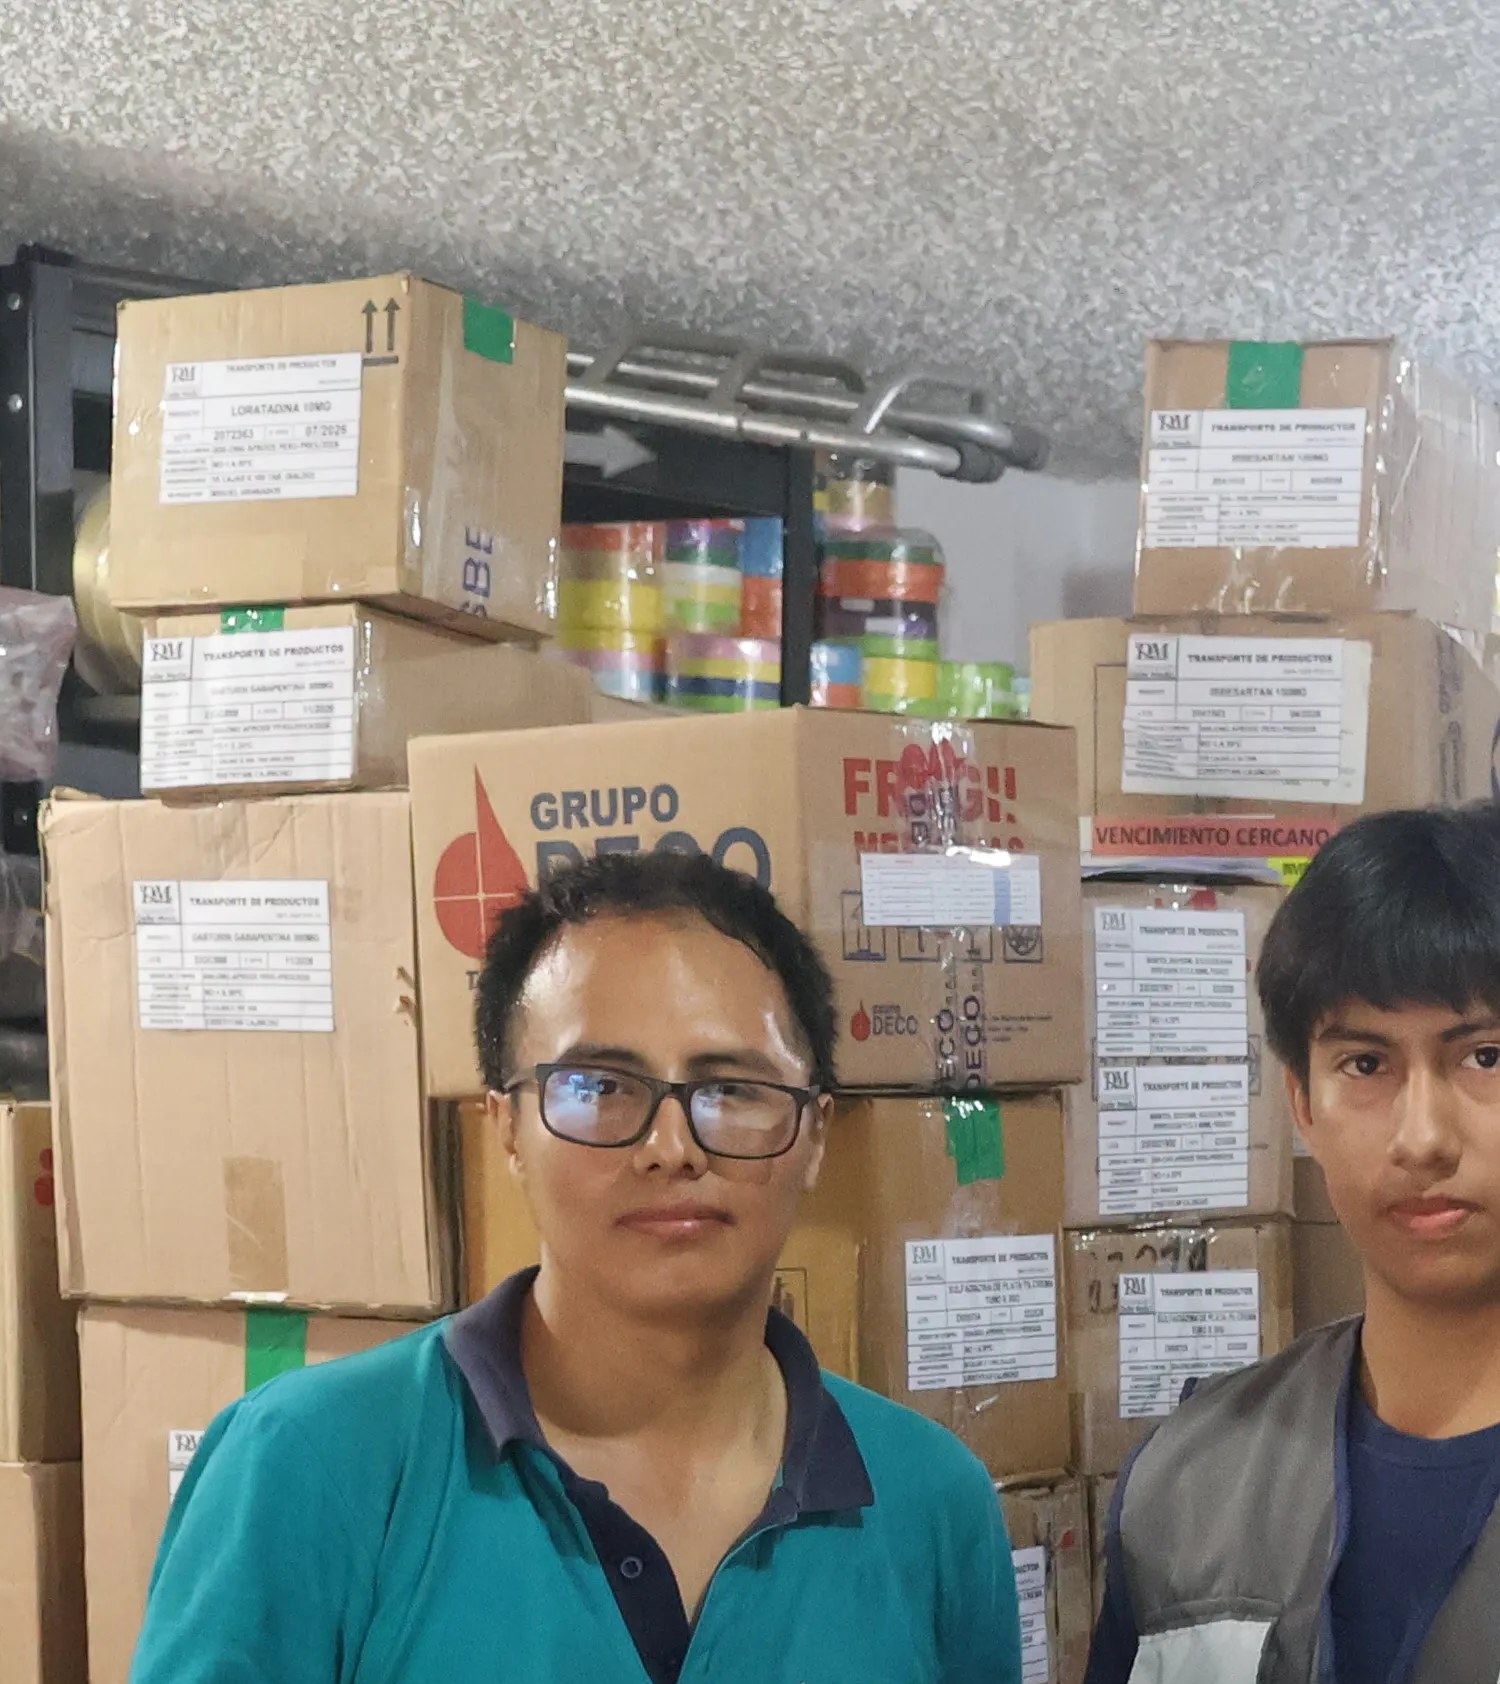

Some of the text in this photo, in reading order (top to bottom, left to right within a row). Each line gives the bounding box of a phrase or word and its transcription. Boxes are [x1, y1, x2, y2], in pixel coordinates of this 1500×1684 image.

[231, 402, 299, 416] LORATADINA
[529, 783, 679, 831] GRUPO
[1096, 826, 1329, 847] VENCIMIENTO CERCANO
[871, 1015, 919, 1037] DECO
